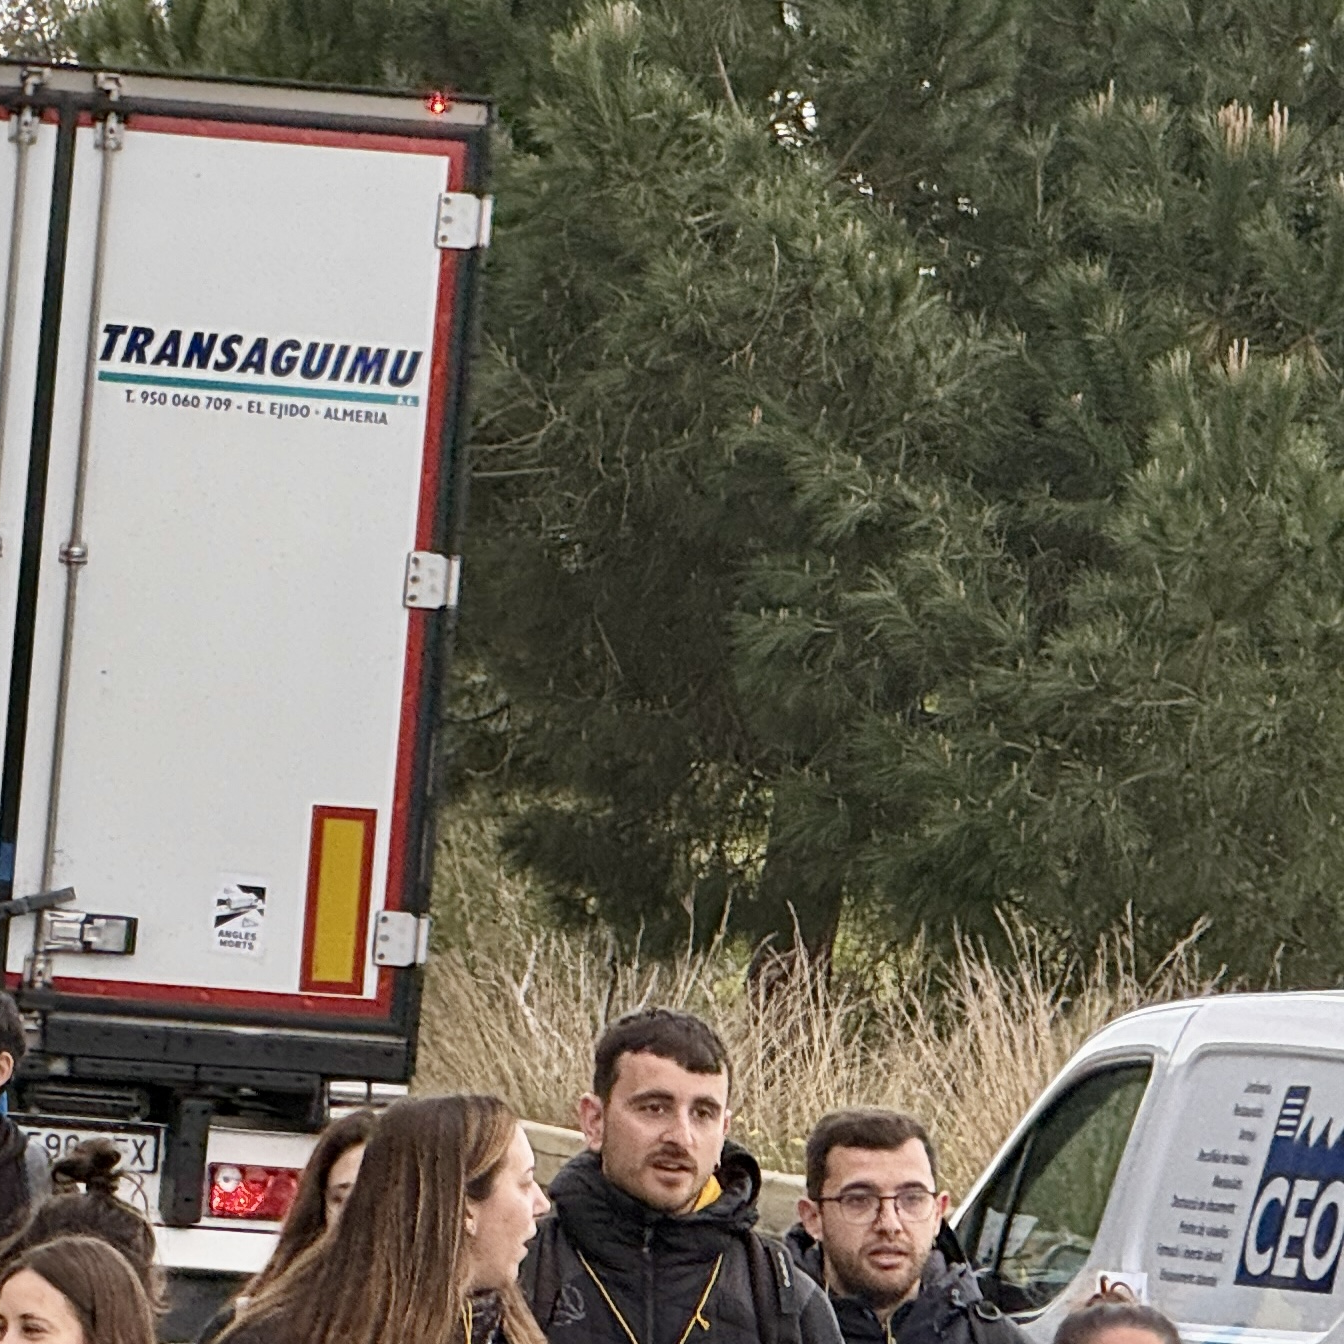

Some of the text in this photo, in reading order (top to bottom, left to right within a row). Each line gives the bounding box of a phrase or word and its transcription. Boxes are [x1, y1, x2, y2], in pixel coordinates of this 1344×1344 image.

[99, 323, 423, 388] TRANSAGUIMU
[141, 390, 166, 406] 950
[172, 392, 200, 409] 060
[206, 396, 231, 412] 709
[247, 401, 264, 414] EL
[269, 402, 310, 419] EJIDO
[324, 408, 387, 425] ALMERIA
[218, 929, 257, 941] ANGLES
